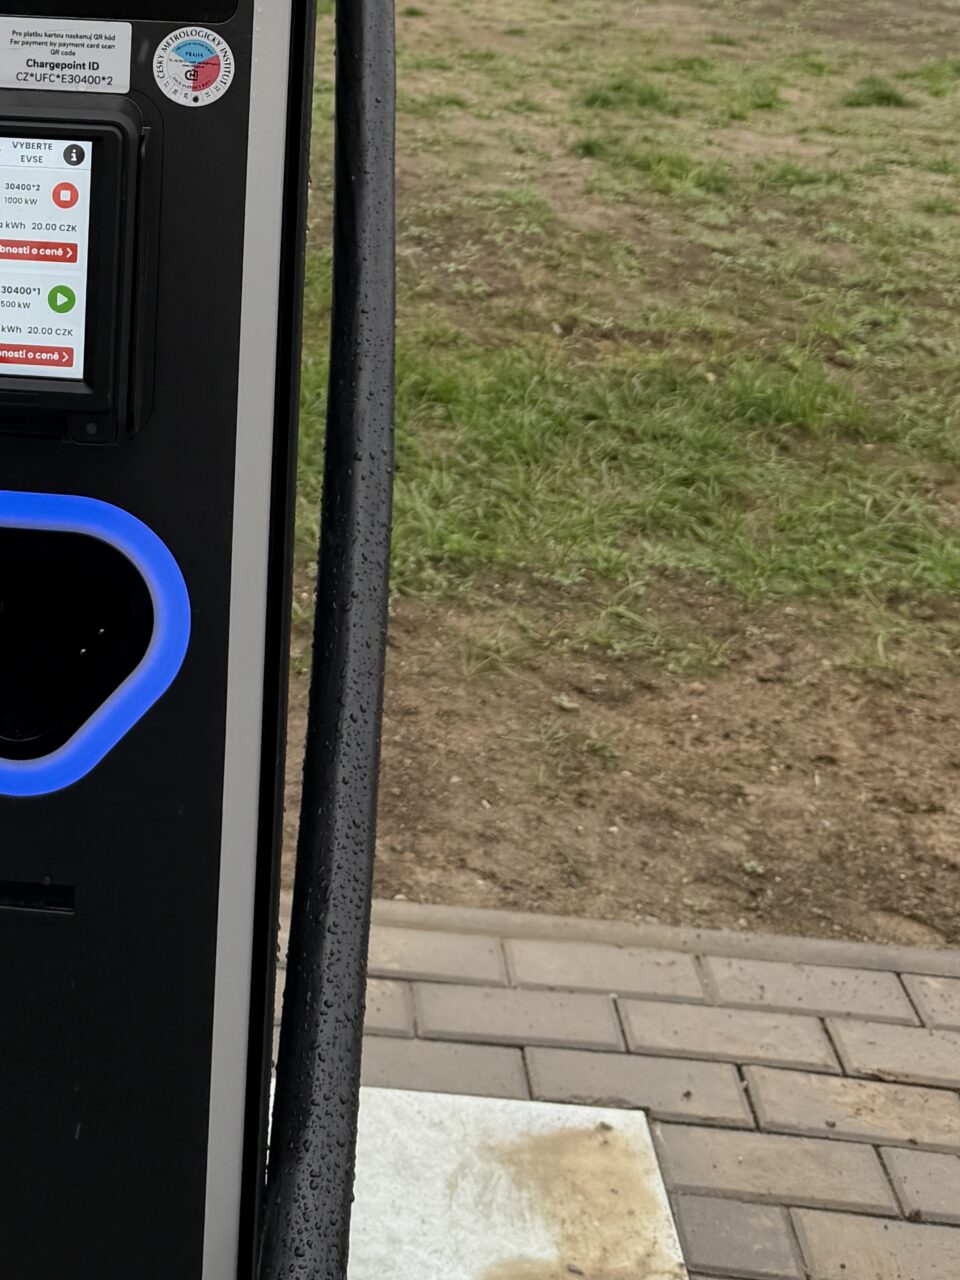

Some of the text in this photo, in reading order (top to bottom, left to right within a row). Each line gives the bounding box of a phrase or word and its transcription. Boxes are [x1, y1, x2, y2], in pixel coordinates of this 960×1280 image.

[44, 31, 64, 39] kartou
[65, 32, 93, 40] naskenuj
[21, 39, 48, 47] payment
[49, 40, 57, 48] by
[58, 41, 85, 49] payment
[25, 58, 99, 71] Chargepoint ID
[220, 47, 231, 86] INSTITUT
[12, 141, 53, 150] VYBERTE
[20, 155, 44, 163] EVSE
[5, 196, 38, 205] 1000 kW
[5, 221, 25, 229] kWh
[31, 222, 57, 231] 20.00
[59, 224, 77, 232] CZK
[0, 300, 31, 309] 500 kW
[1, 324, 22, 333] kWh
[28, 326, 53, 335] 20.00
[55, 328, 73, 336] CZK
[35, 351, 59, 360] ceně
